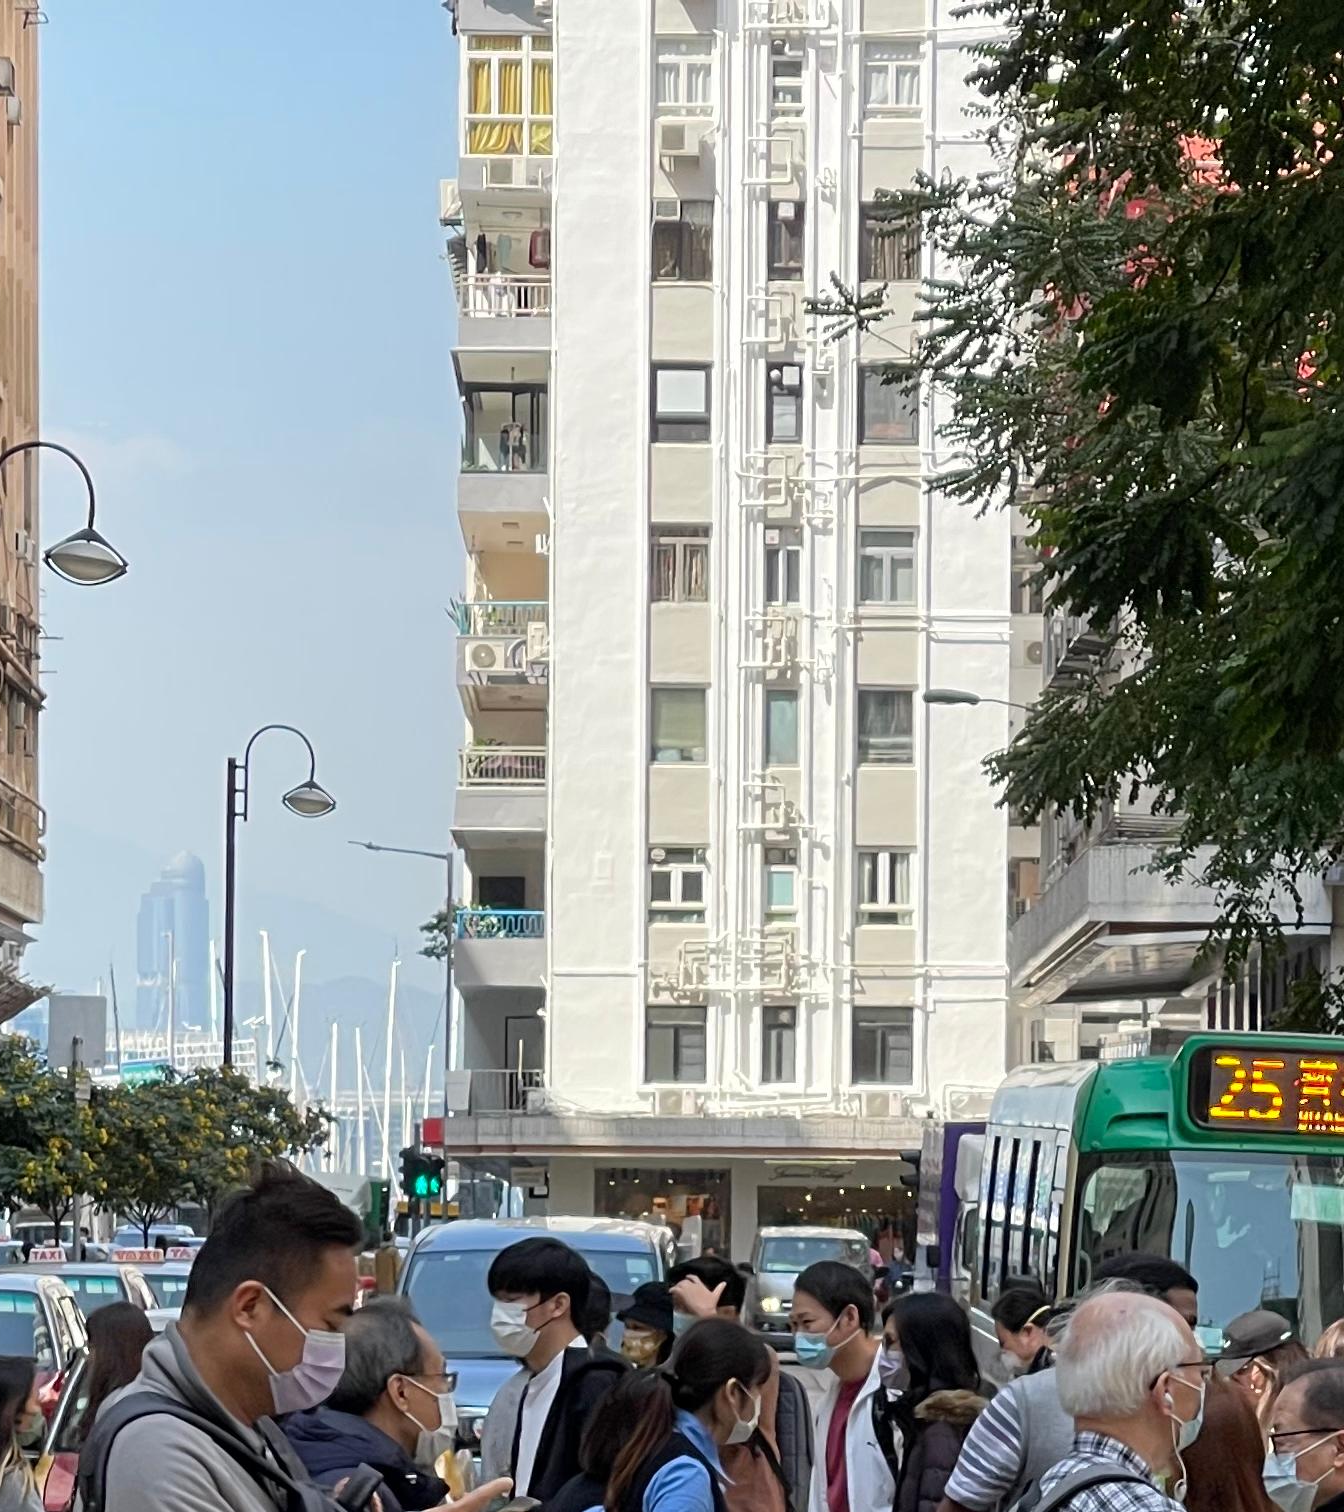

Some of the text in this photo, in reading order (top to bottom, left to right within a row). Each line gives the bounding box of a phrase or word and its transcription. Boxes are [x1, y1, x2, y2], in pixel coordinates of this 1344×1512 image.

[1209, 1057, 1285, 1119] 25
[32, 1251, 63, 1261] TAXI
[115, 1250, 161, 1261] TAXI
